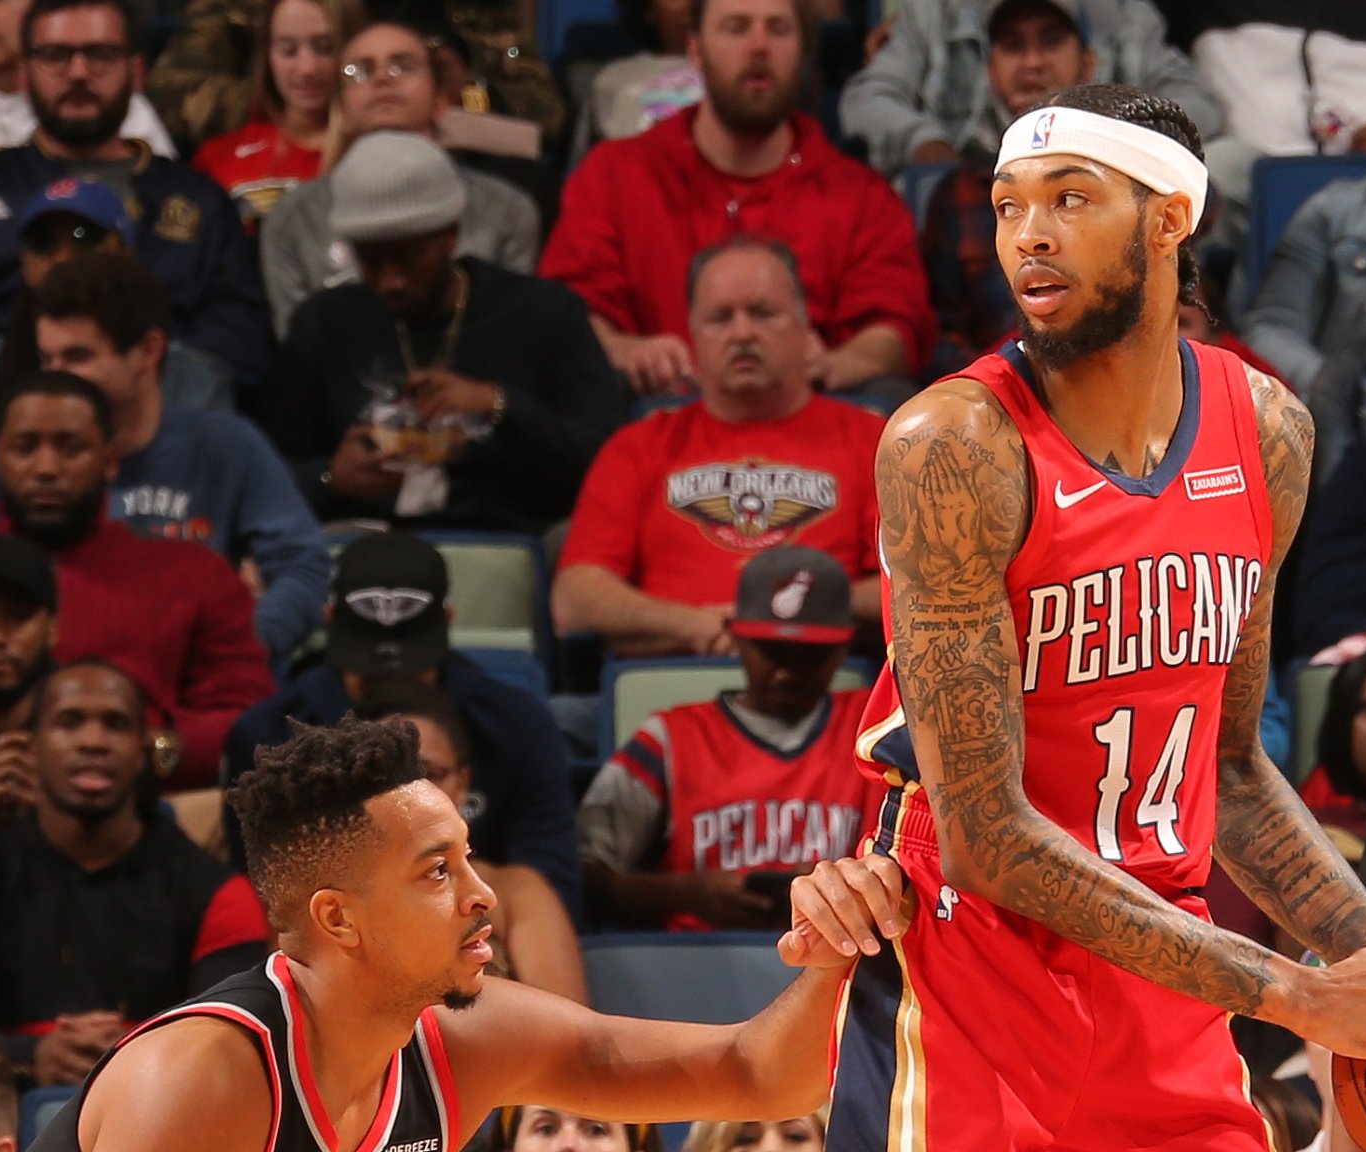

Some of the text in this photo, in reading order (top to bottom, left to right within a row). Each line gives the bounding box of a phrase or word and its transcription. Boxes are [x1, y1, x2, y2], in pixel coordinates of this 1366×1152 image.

[893, 427, 935, 460] Dear
[123, 486, 191, 519] YORK
[667, 466, 837, 510] NEW ORLEANS
[1092, 703, 1198, 862] 14
